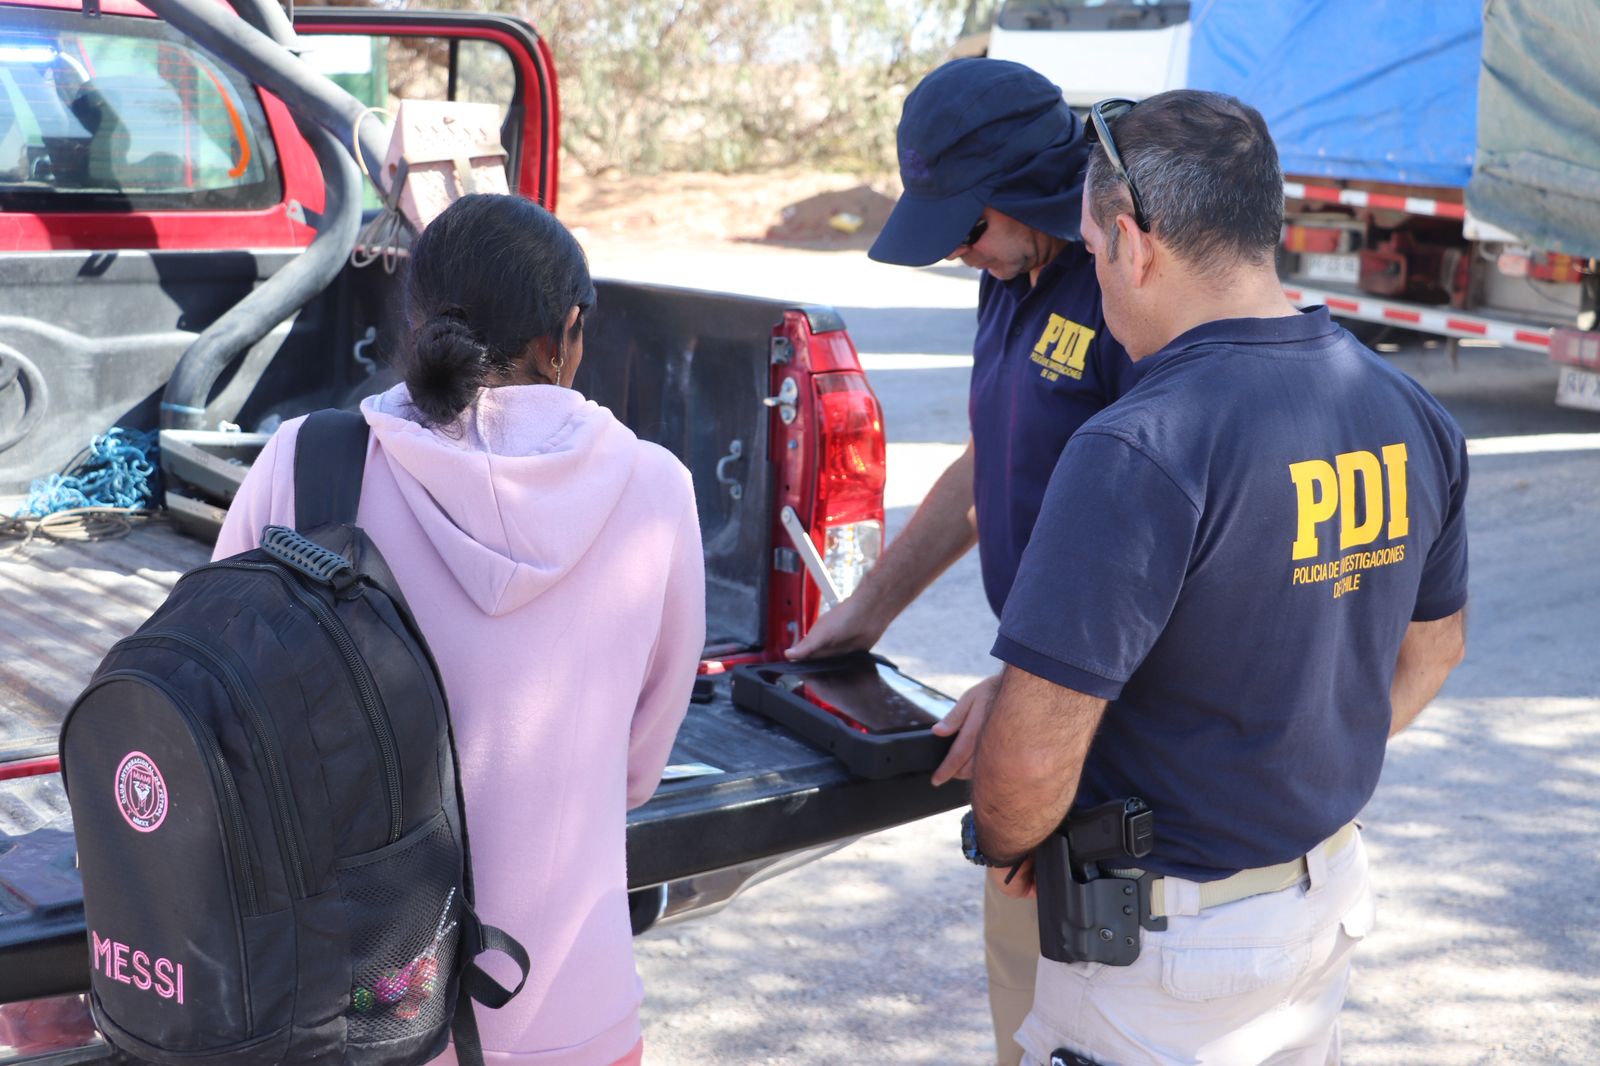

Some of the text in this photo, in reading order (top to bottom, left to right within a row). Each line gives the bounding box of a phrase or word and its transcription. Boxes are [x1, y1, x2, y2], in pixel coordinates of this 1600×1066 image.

[1034, 312, 1096, 372] PDI
[1289, 443, 1409, 561] PDI
[1292, 563, 1328, 586] POLICIA
[1328, 560, 1340, 579] DE
[132, 770, 152, 784] MIAMI
[92, 930, 184, 1005] MESSI
